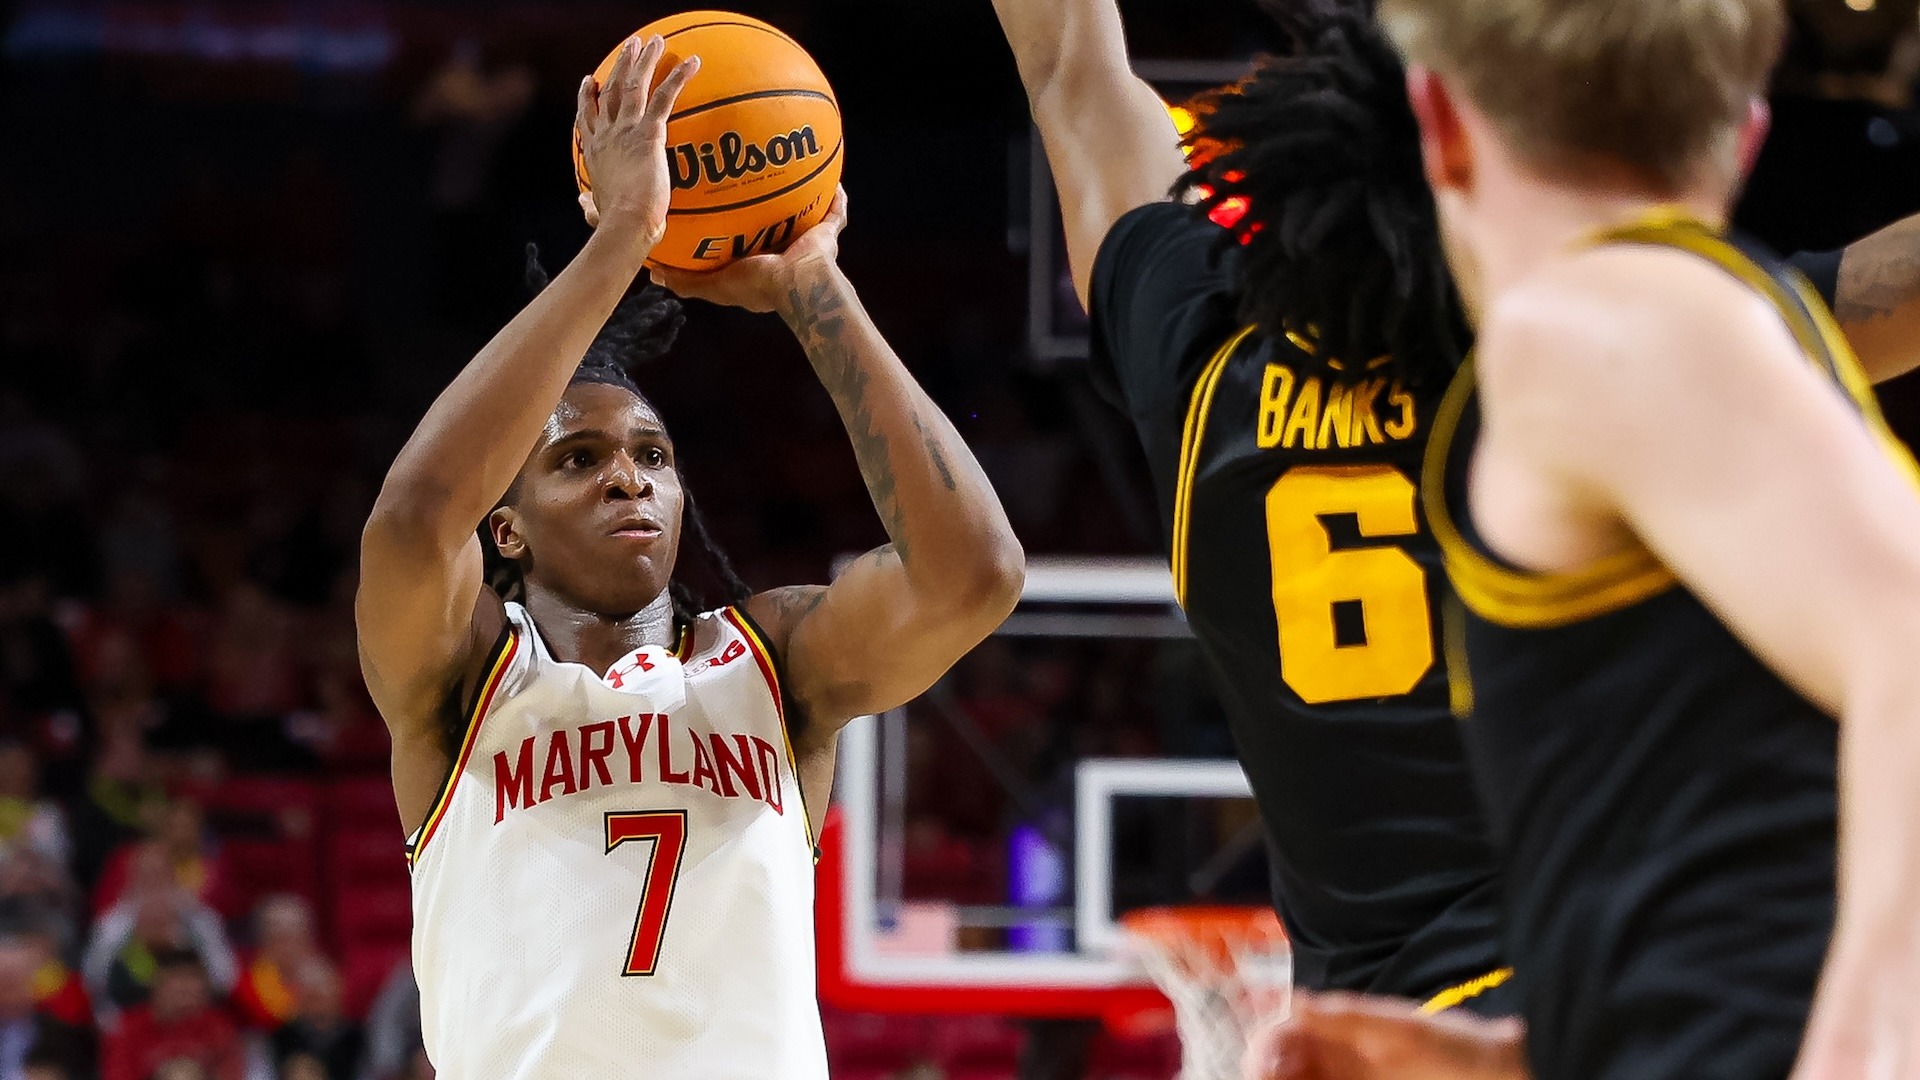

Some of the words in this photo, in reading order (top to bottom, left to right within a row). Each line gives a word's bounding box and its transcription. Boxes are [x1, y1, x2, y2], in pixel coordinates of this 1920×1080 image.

[666, 124, 819, 191] Wilson
[692, 213, 797, 260] EVO
[1257, 362, 1417, 450] BANKS
[1265, 464, 1435, 704] 6
[493, 713, 784, 826] MARYLAND
[604, 809, 688, 977] 7
